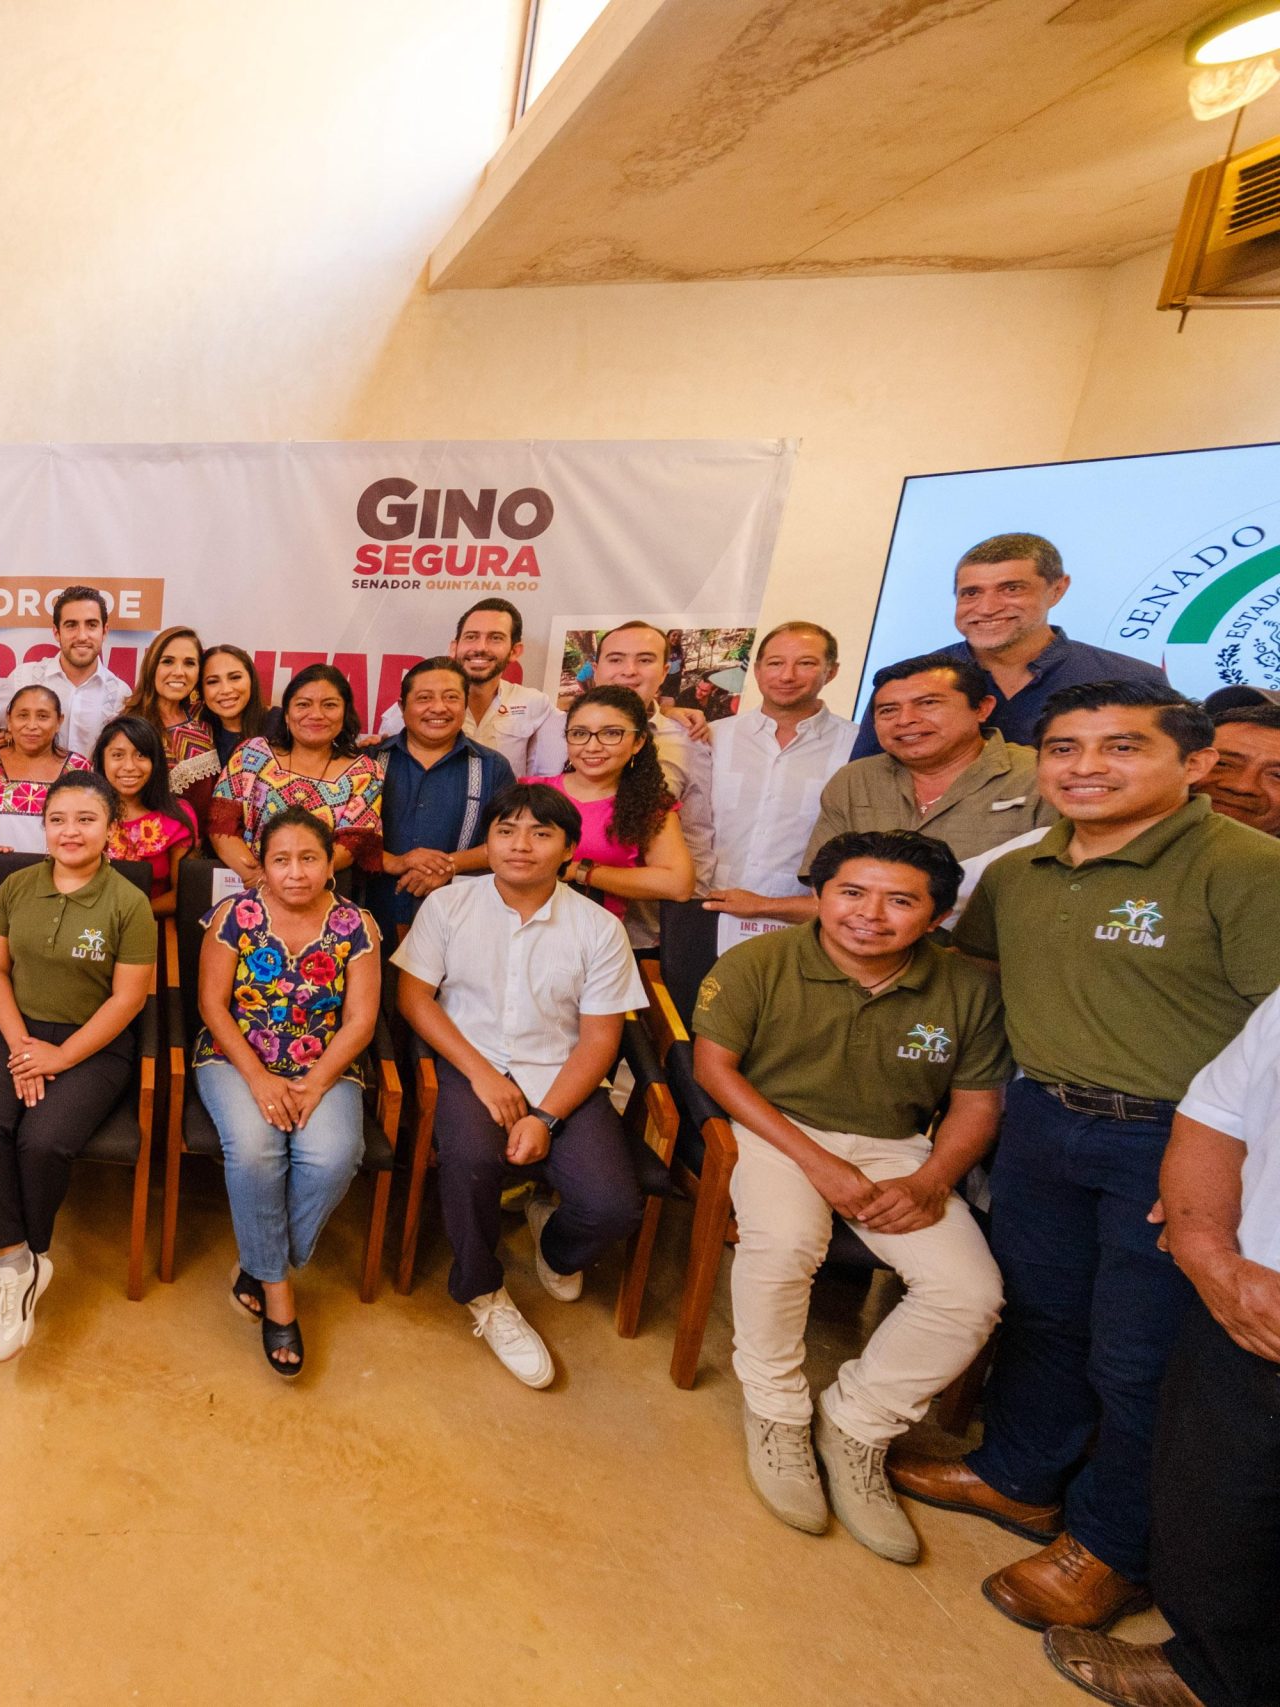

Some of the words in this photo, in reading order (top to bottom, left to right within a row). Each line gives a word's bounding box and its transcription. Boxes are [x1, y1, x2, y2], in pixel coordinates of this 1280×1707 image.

[356, 477, 554, 541] GINO
[353, 543, 541, 577] SEGURA
[351, 579, 421, 590] SENADOR
[425, 580, 502, 591] QUINTANA
[506, 581, 539, 591] ROO
[1120, 525, 1266, 640] SENADO
[1225, 586, 1280, 639] ESTAD
[740, 921, 761, 933] ING.
